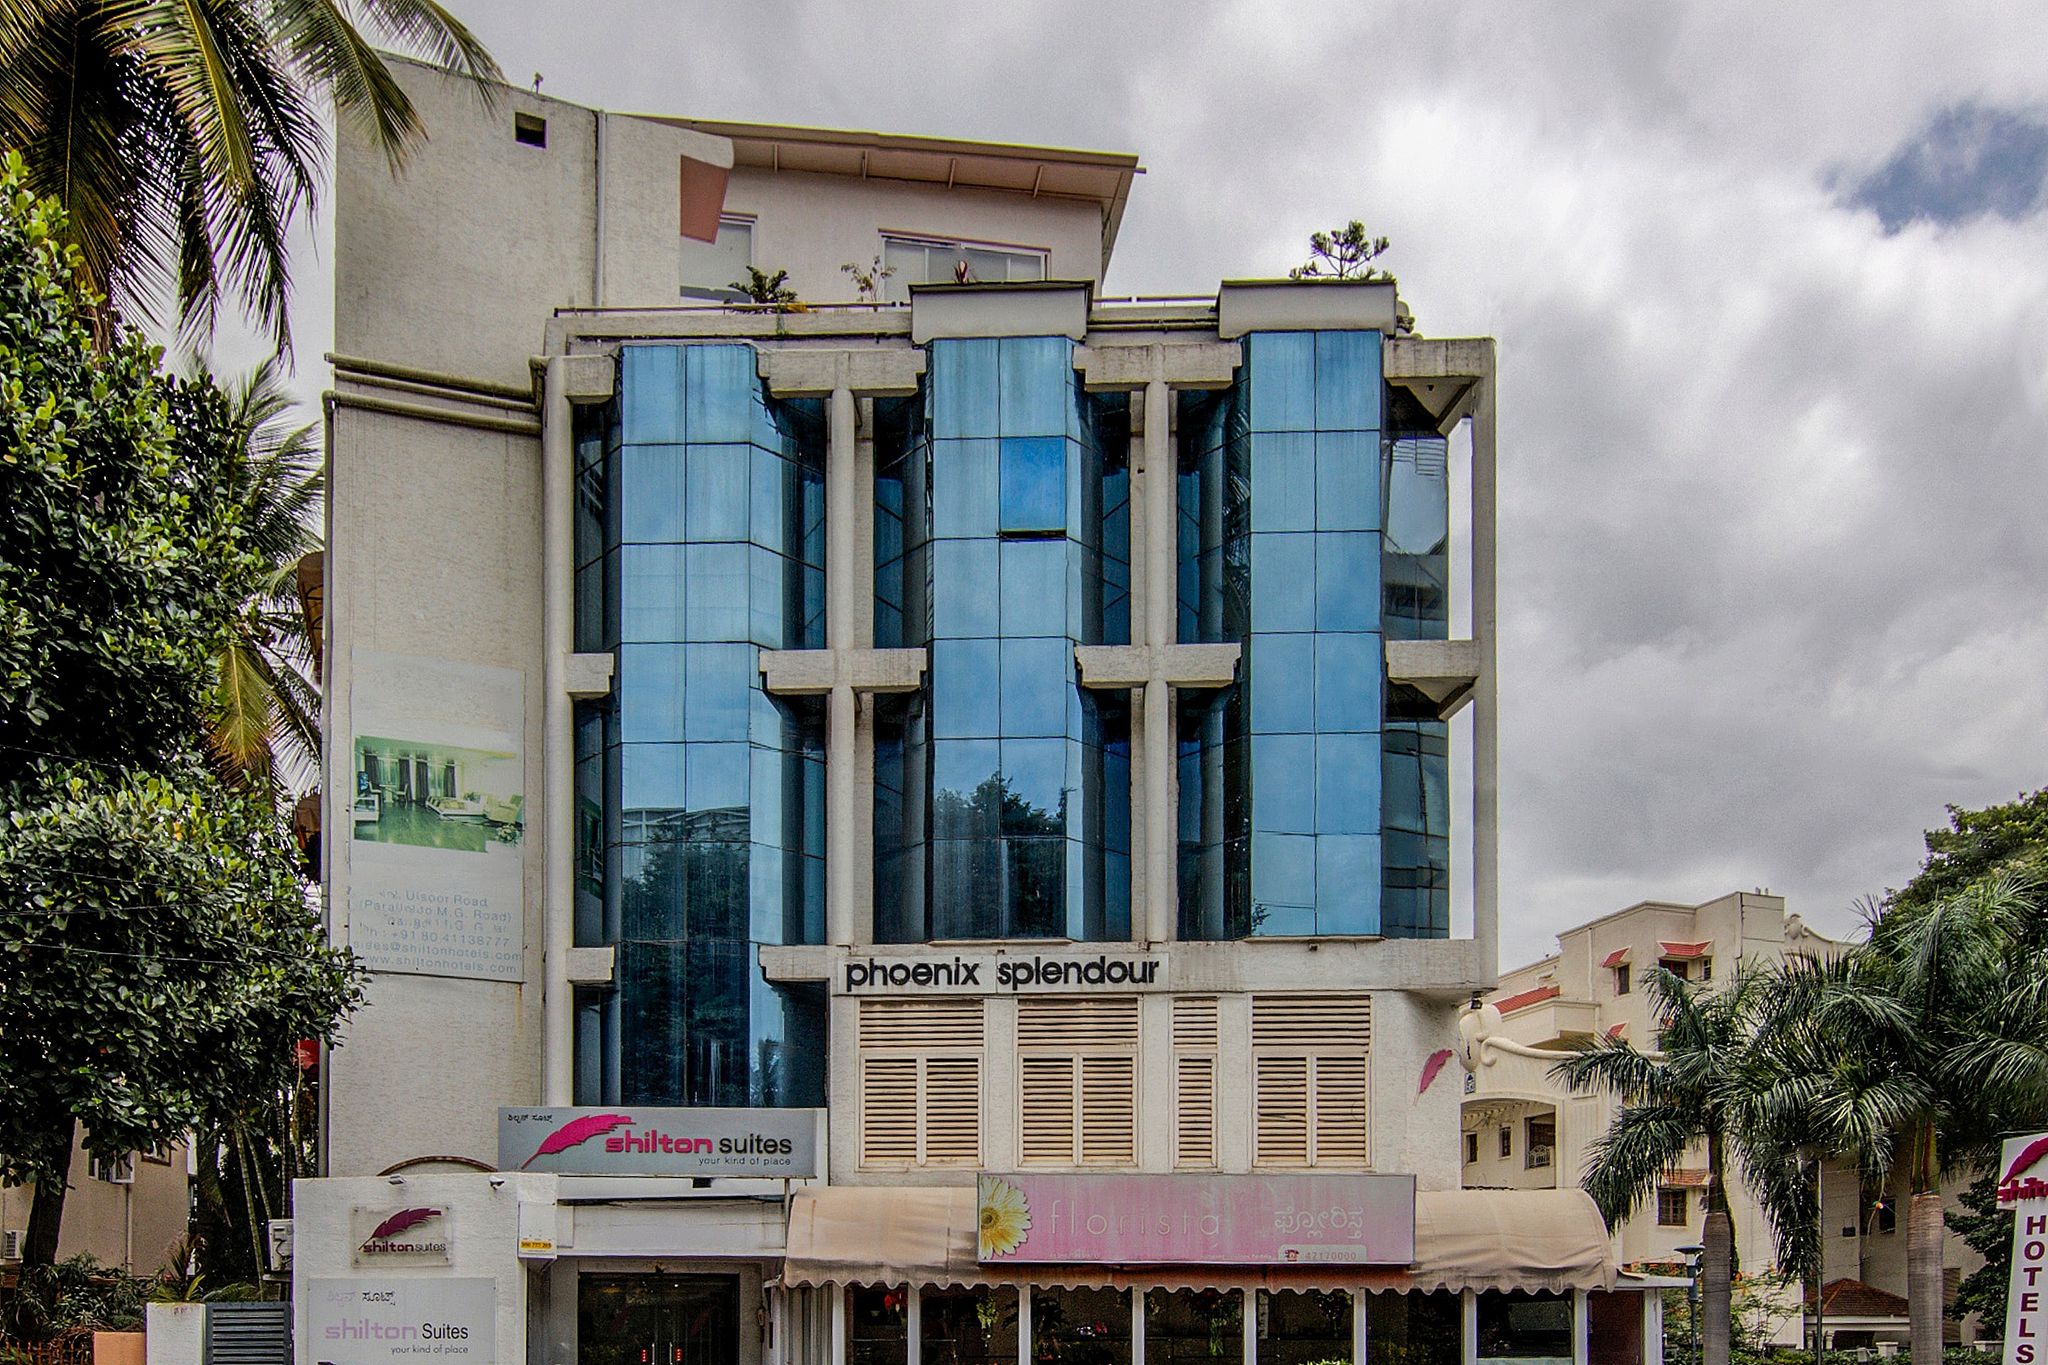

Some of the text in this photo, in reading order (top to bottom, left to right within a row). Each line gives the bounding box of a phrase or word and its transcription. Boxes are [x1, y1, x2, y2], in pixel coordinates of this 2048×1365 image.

[454, 894, 489, 907] Road
[846, 955, 1160, 992] phoenix splendour
[604, 1129, 793, 1155] shilton suites
[698, 1155, 792, 1168] your kind of place
[1049, 1198, 1220, 1237] florista
[362, 1240, 447, 1253] shilton suites
[2015, 1215, 2047, 1364] HOTELS
[325, 1318, 469, 1340] shilton Suites
[390, 1344, 469, 1356] your kind of place
